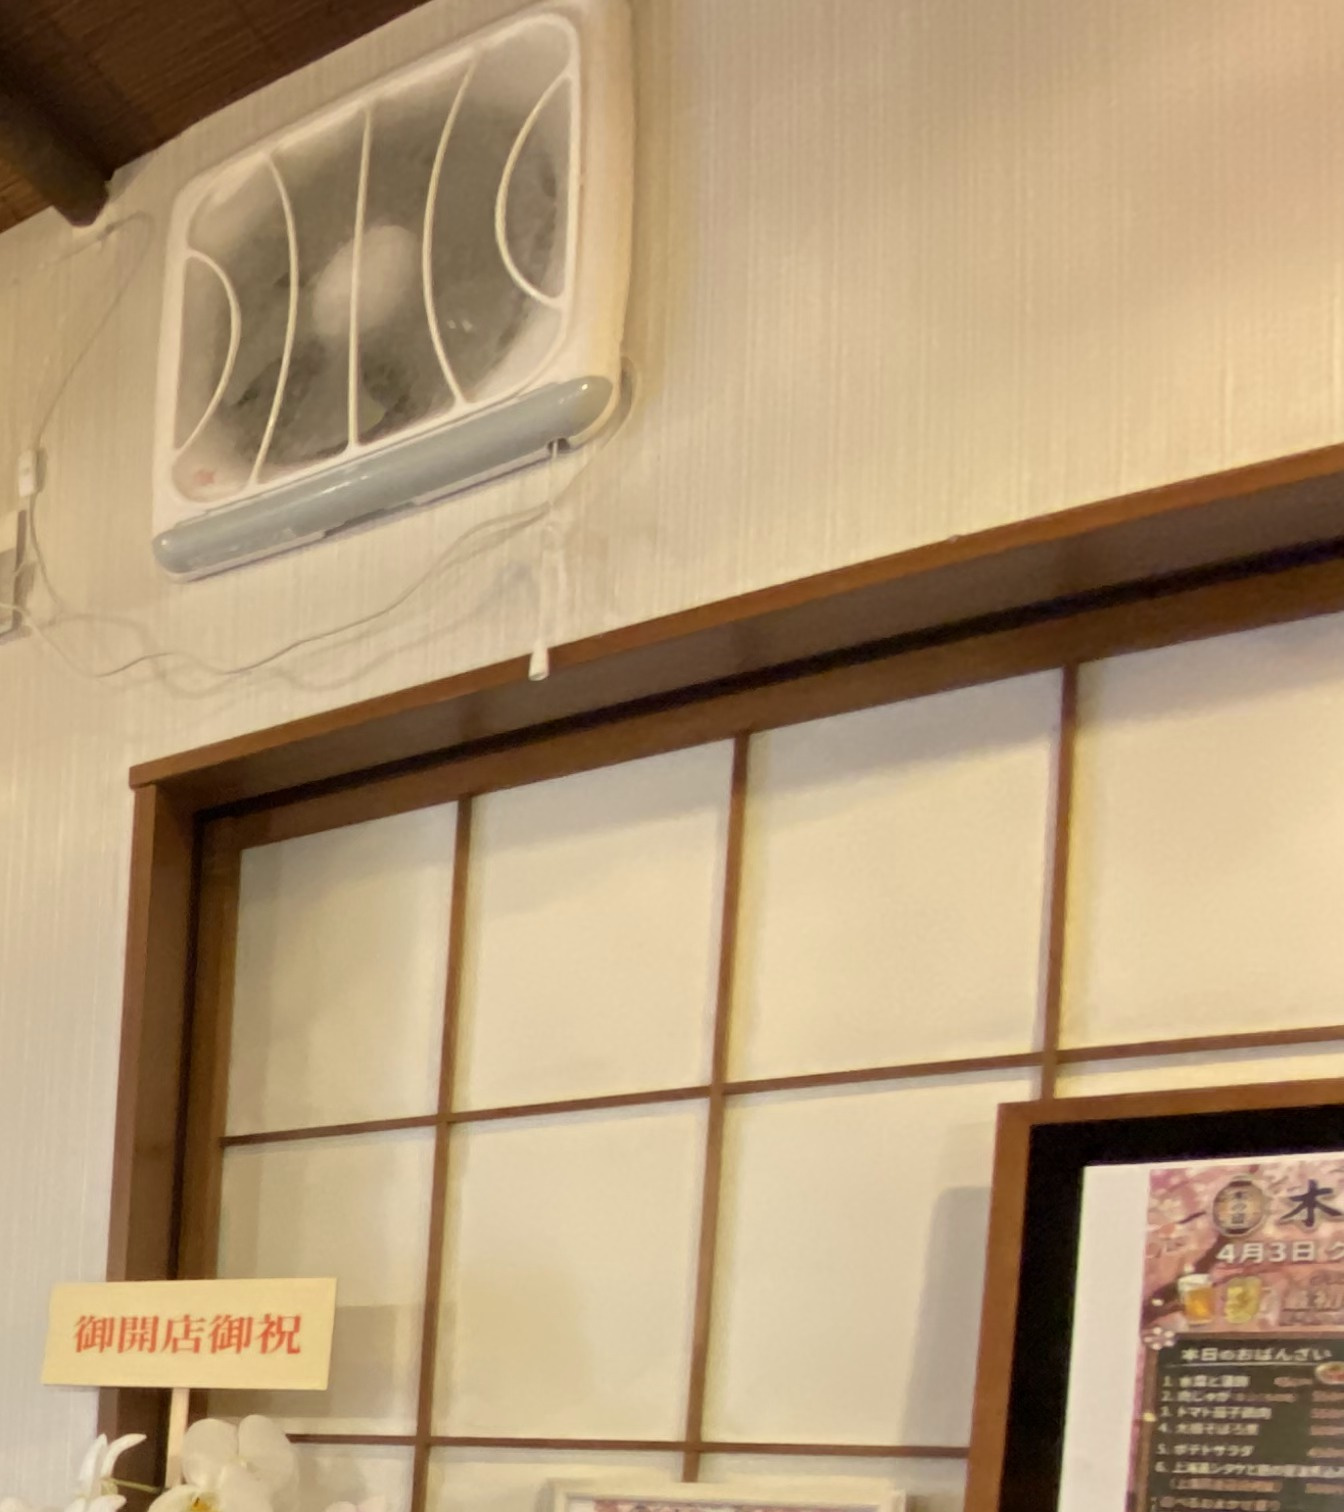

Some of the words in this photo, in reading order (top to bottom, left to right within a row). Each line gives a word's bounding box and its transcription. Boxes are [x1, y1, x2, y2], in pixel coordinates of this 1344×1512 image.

[74, 1313, 302, 1355] 御開店御祝
